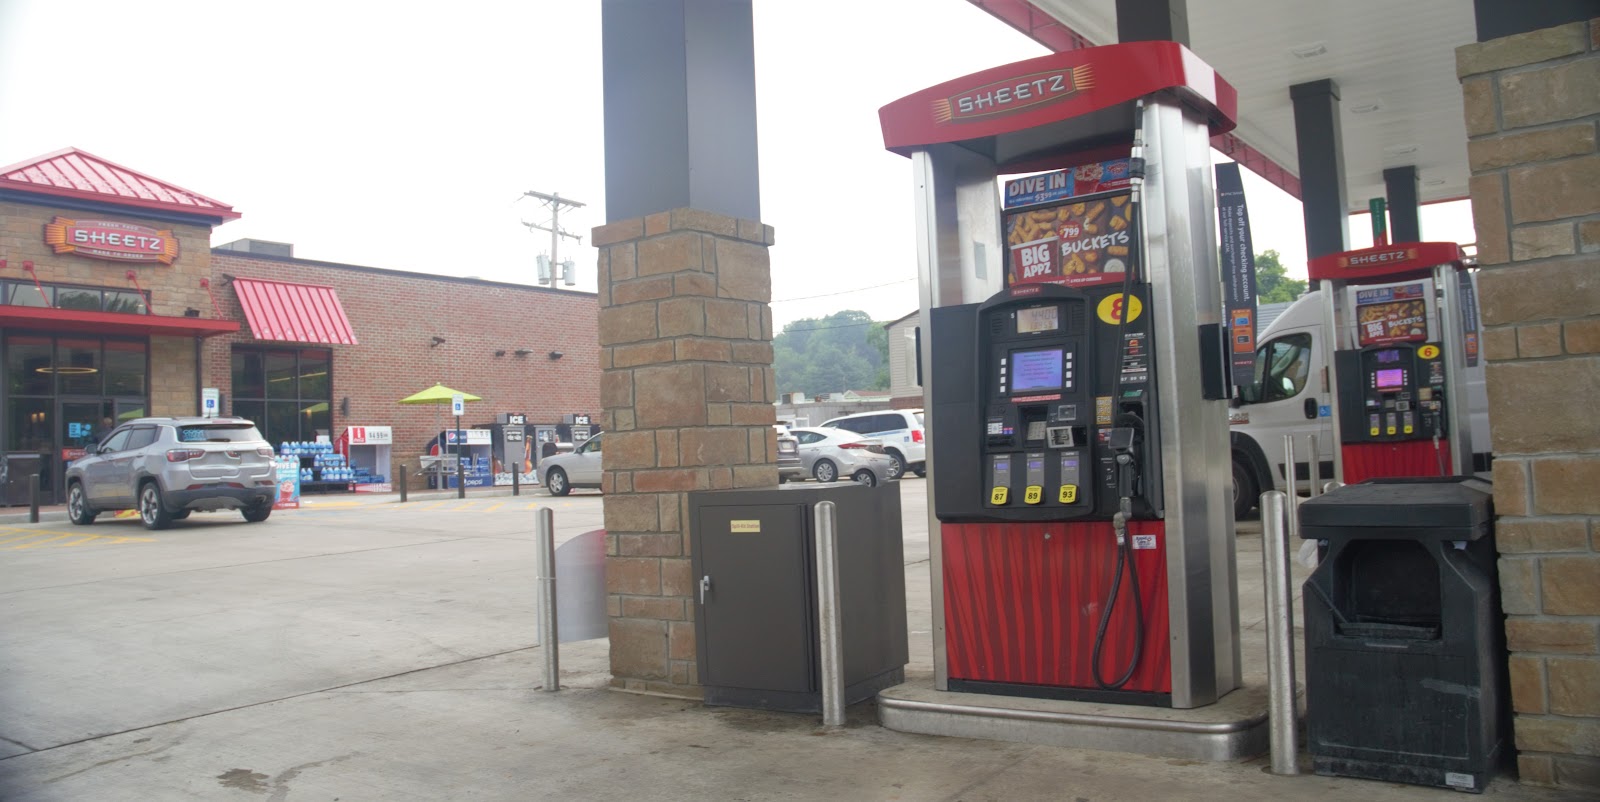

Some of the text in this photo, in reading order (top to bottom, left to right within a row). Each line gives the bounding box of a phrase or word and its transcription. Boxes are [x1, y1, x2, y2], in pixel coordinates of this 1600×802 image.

[958, 74, 1066, 113] SHEETZ
[1009, 171, 1066, 196] DIVE IN
[75, 229, 161, 250] SHEETZ
[1061, 231, 1129, 256] BUCKETS
[1021, 244, 1050, 266] BIG
[1236, 204, 1251, 302] Top off your checking account.
[1350, 251, 1405, 265] SHEETZ
[1023, 261, 1052, 278] APPZ
[1360, 291, 1378, 299] DIVE
[1367, 322, 1383, 333] BIG
[1388, 316, 1423, 328] BUCKETS
[1424, 347, 1433, 357] 6
[510, 416, 524, 424] ICE
[575, 416, 588, 424] ICE
[994, 493, 1004, 501] 87
[1028, 492, 1038, 500] 89
[1062, 491, 1073, 499] 93
